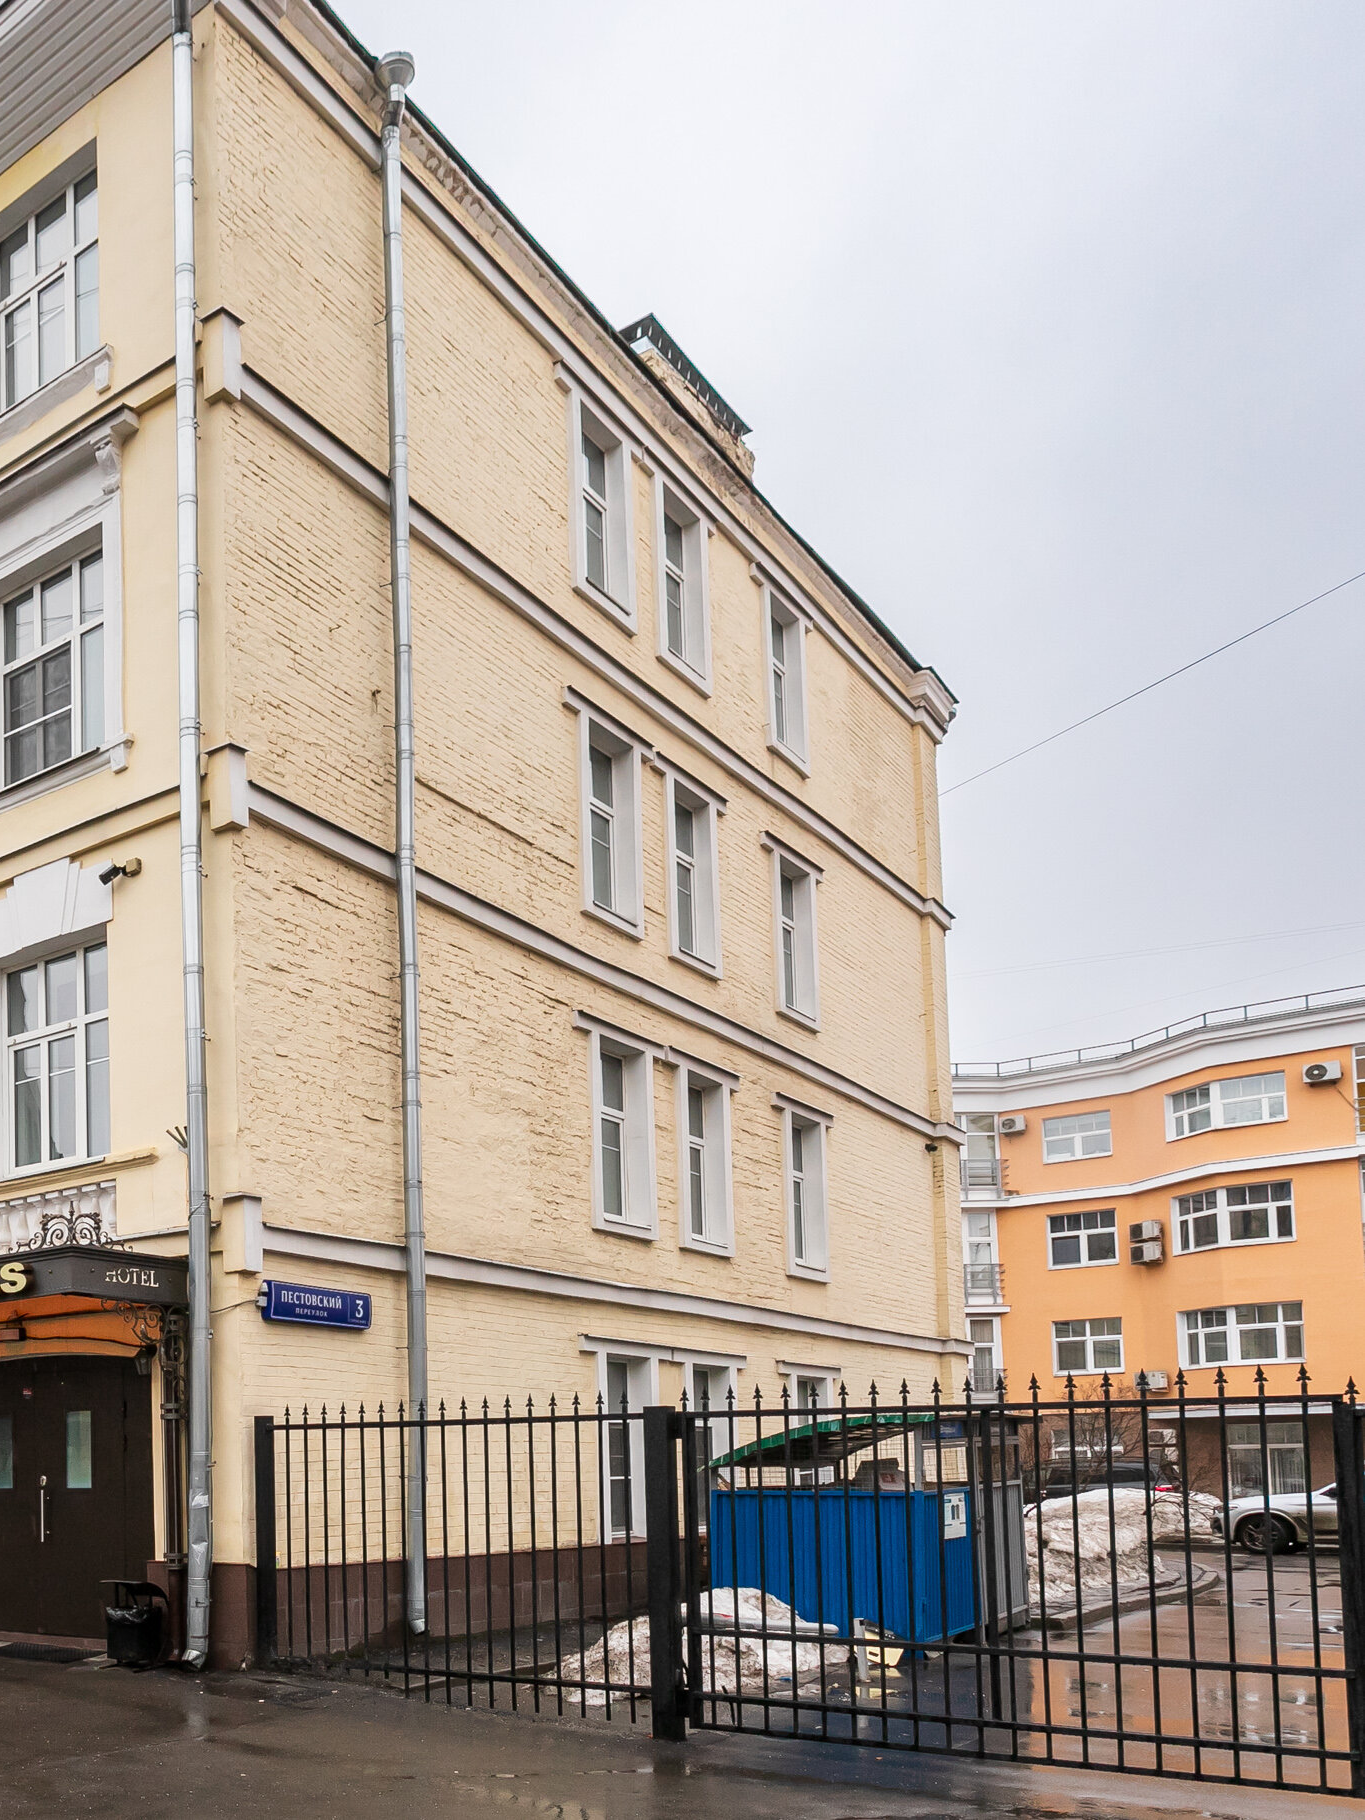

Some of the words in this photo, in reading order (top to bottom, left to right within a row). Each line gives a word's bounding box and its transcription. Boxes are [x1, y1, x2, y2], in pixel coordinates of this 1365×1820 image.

[104, 1268, 160, 1288] HOTEL
[281, 1289, 342, 1309] ПЕСТОВСКИЙ
[355, 1299, 364, 1318] 3
[295, 1307, 328, 1318] ПЕРЕУЛОК
